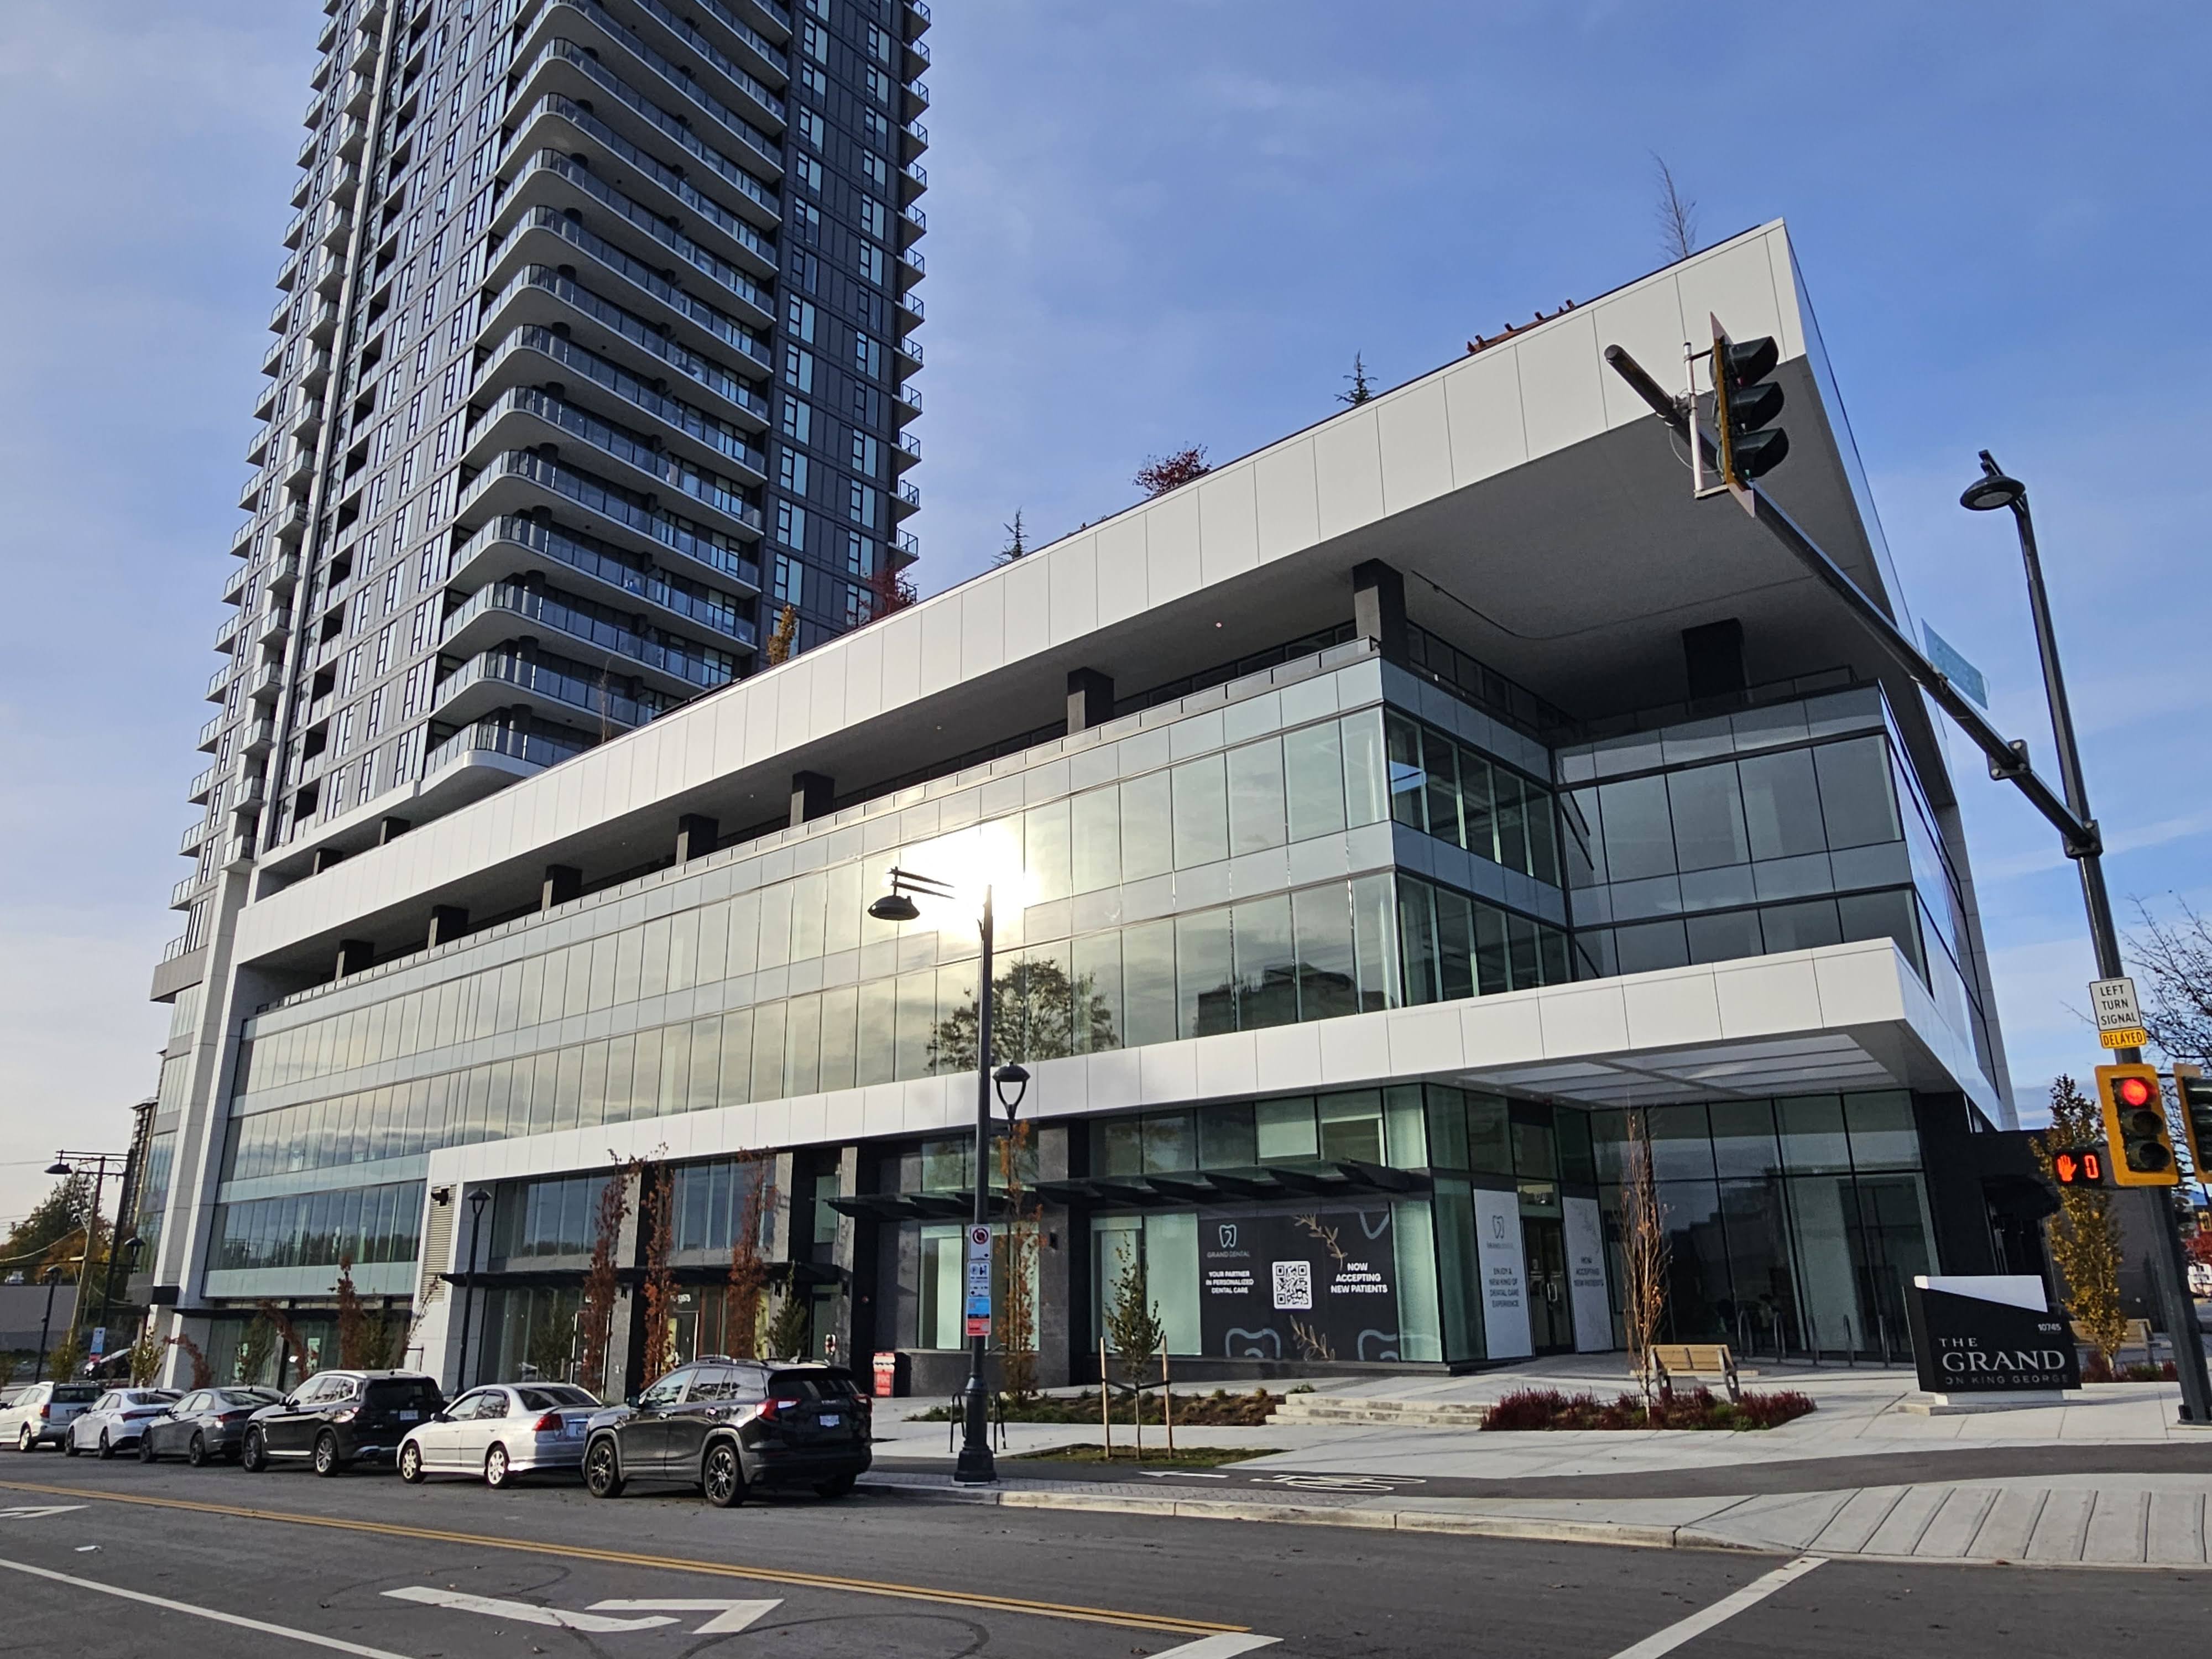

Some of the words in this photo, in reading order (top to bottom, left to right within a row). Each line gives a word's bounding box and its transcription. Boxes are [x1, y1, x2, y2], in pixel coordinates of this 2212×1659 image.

[2100, 984, 2124, 997] LEFT
[2101, 998, 2128, 1010] TURN
[2101, 1012, 2137, 1025] SIGNAL
[2103, 1031, 2143, 1046] DELAYED
[1347, 1262, 1368, 1271] NOW
[1335, 1273, 1381, 1282] ACCEPTING
[1331, 1285, 1350, 1293] NEW
[1351, 1284, 1388, 1293] PATIENTS
[2037, 1323, 2062, 1332] 10745
[1939, 1337, 1978, 1347] THE
[1942, 1350, 2065, 1372] GRAND
[1945, 1376, 1964, 1385] ON
[1972, 1375, 2006, 1385] KING
[2012, 1374, 2068, 1384] GEORGE
